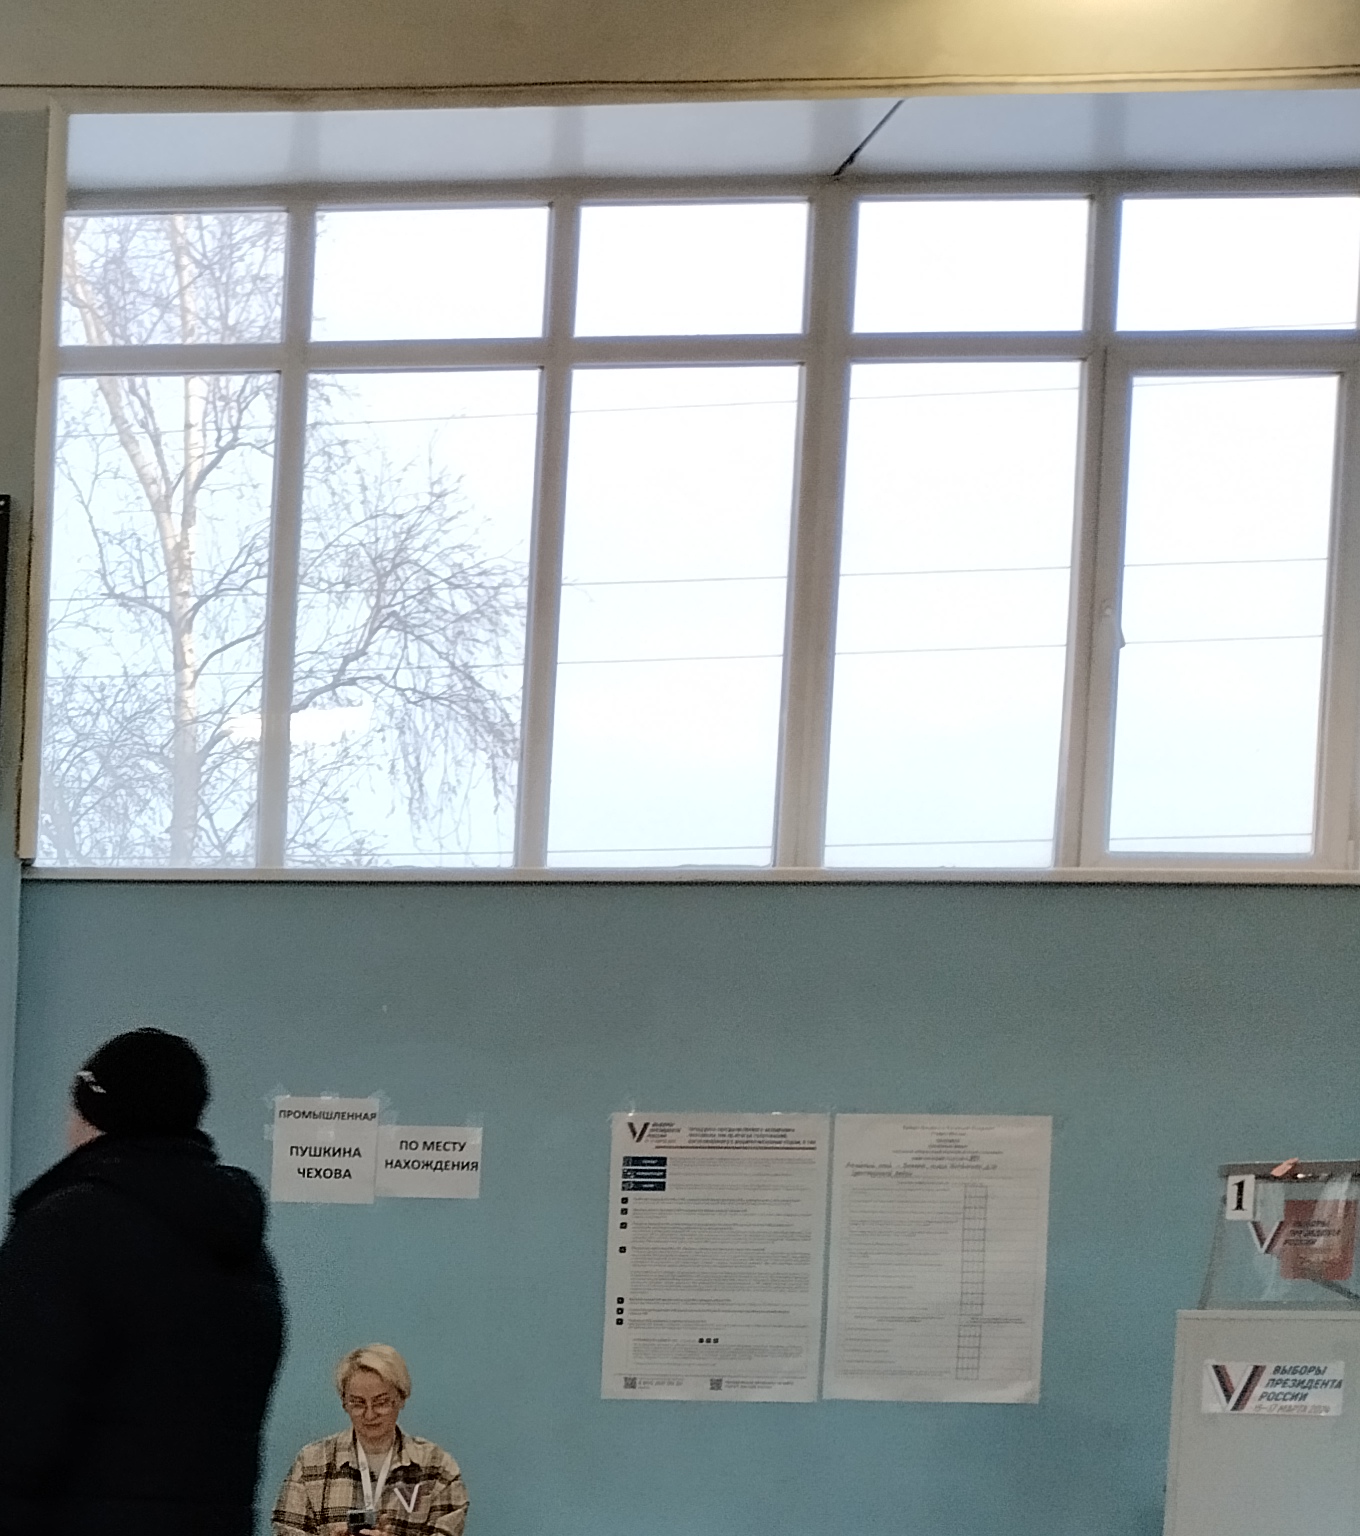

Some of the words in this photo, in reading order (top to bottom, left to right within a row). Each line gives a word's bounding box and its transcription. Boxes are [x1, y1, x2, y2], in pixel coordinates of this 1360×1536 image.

[278, 1109, 377, 1121] ПРОМЫШЛЕННАЯ
[289, 1145, 362, 1158] ПУШКИНА
[399, 1140, 419, 1151] ПО
[422, 1141, 467, 1152] МЕСТУ
[384, 1158, 479, 1172] НАХОЖДЕНИЯ
[297, 1167, 352, 1179] ЧЕХОВА
[1231, 1178, 1248, 1211] 1
[1272, 1365, 1328, 1376] ВЫБОРЫ
[1264, 1378, 1344, 1390] ПРЕЗИДЕНТА
[1257, 1391, 1309, 1402] РОССИИ
